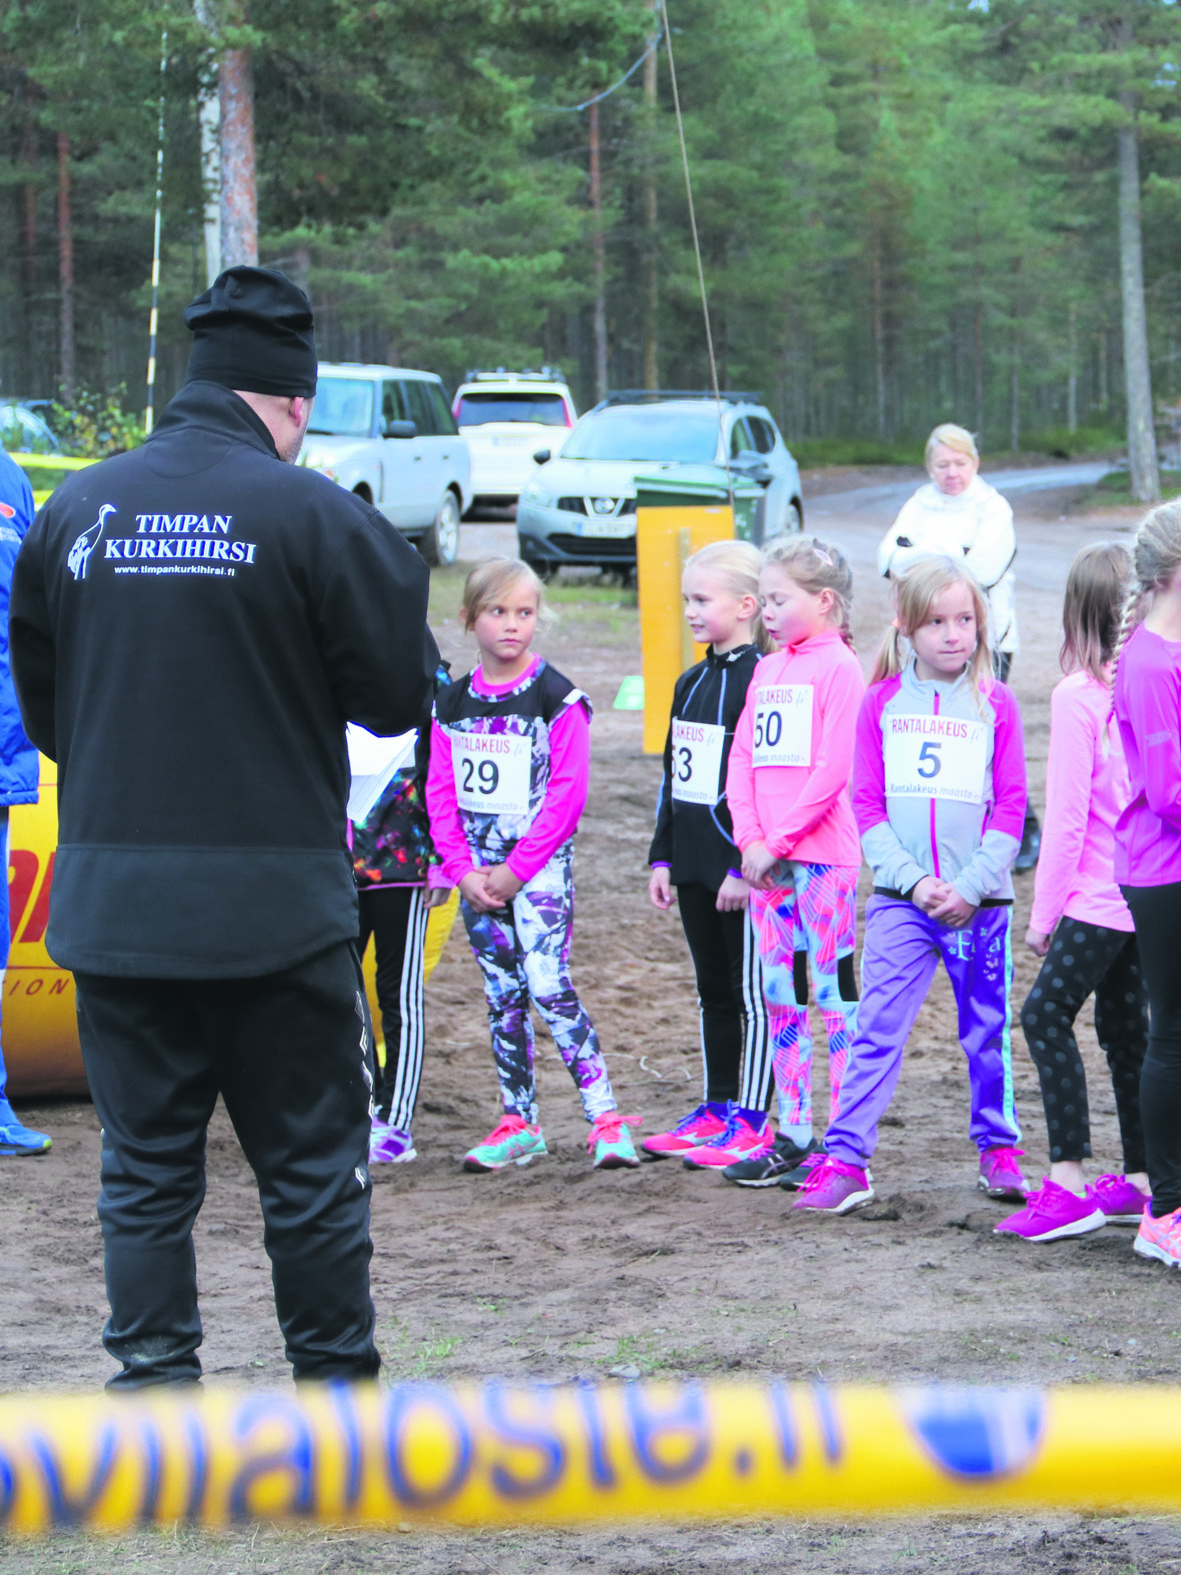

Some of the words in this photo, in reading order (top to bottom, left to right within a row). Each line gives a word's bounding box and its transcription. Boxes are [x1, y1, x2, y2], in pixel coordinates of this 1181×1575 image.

[135, 514, 233, 535] TIMPAN
[103, 538, 257, 564] KURKIHIRSI
[114, 565, 236, 577] www.timpankurkihirsi.fi
[755, 711, 782, 748] 50
[892, 718, 967, 738] RANTALAKEUS
[917, 741, 942, 778] 5
[462, 758, 499, 795] 29
[3, 978, 70, 996] ION
